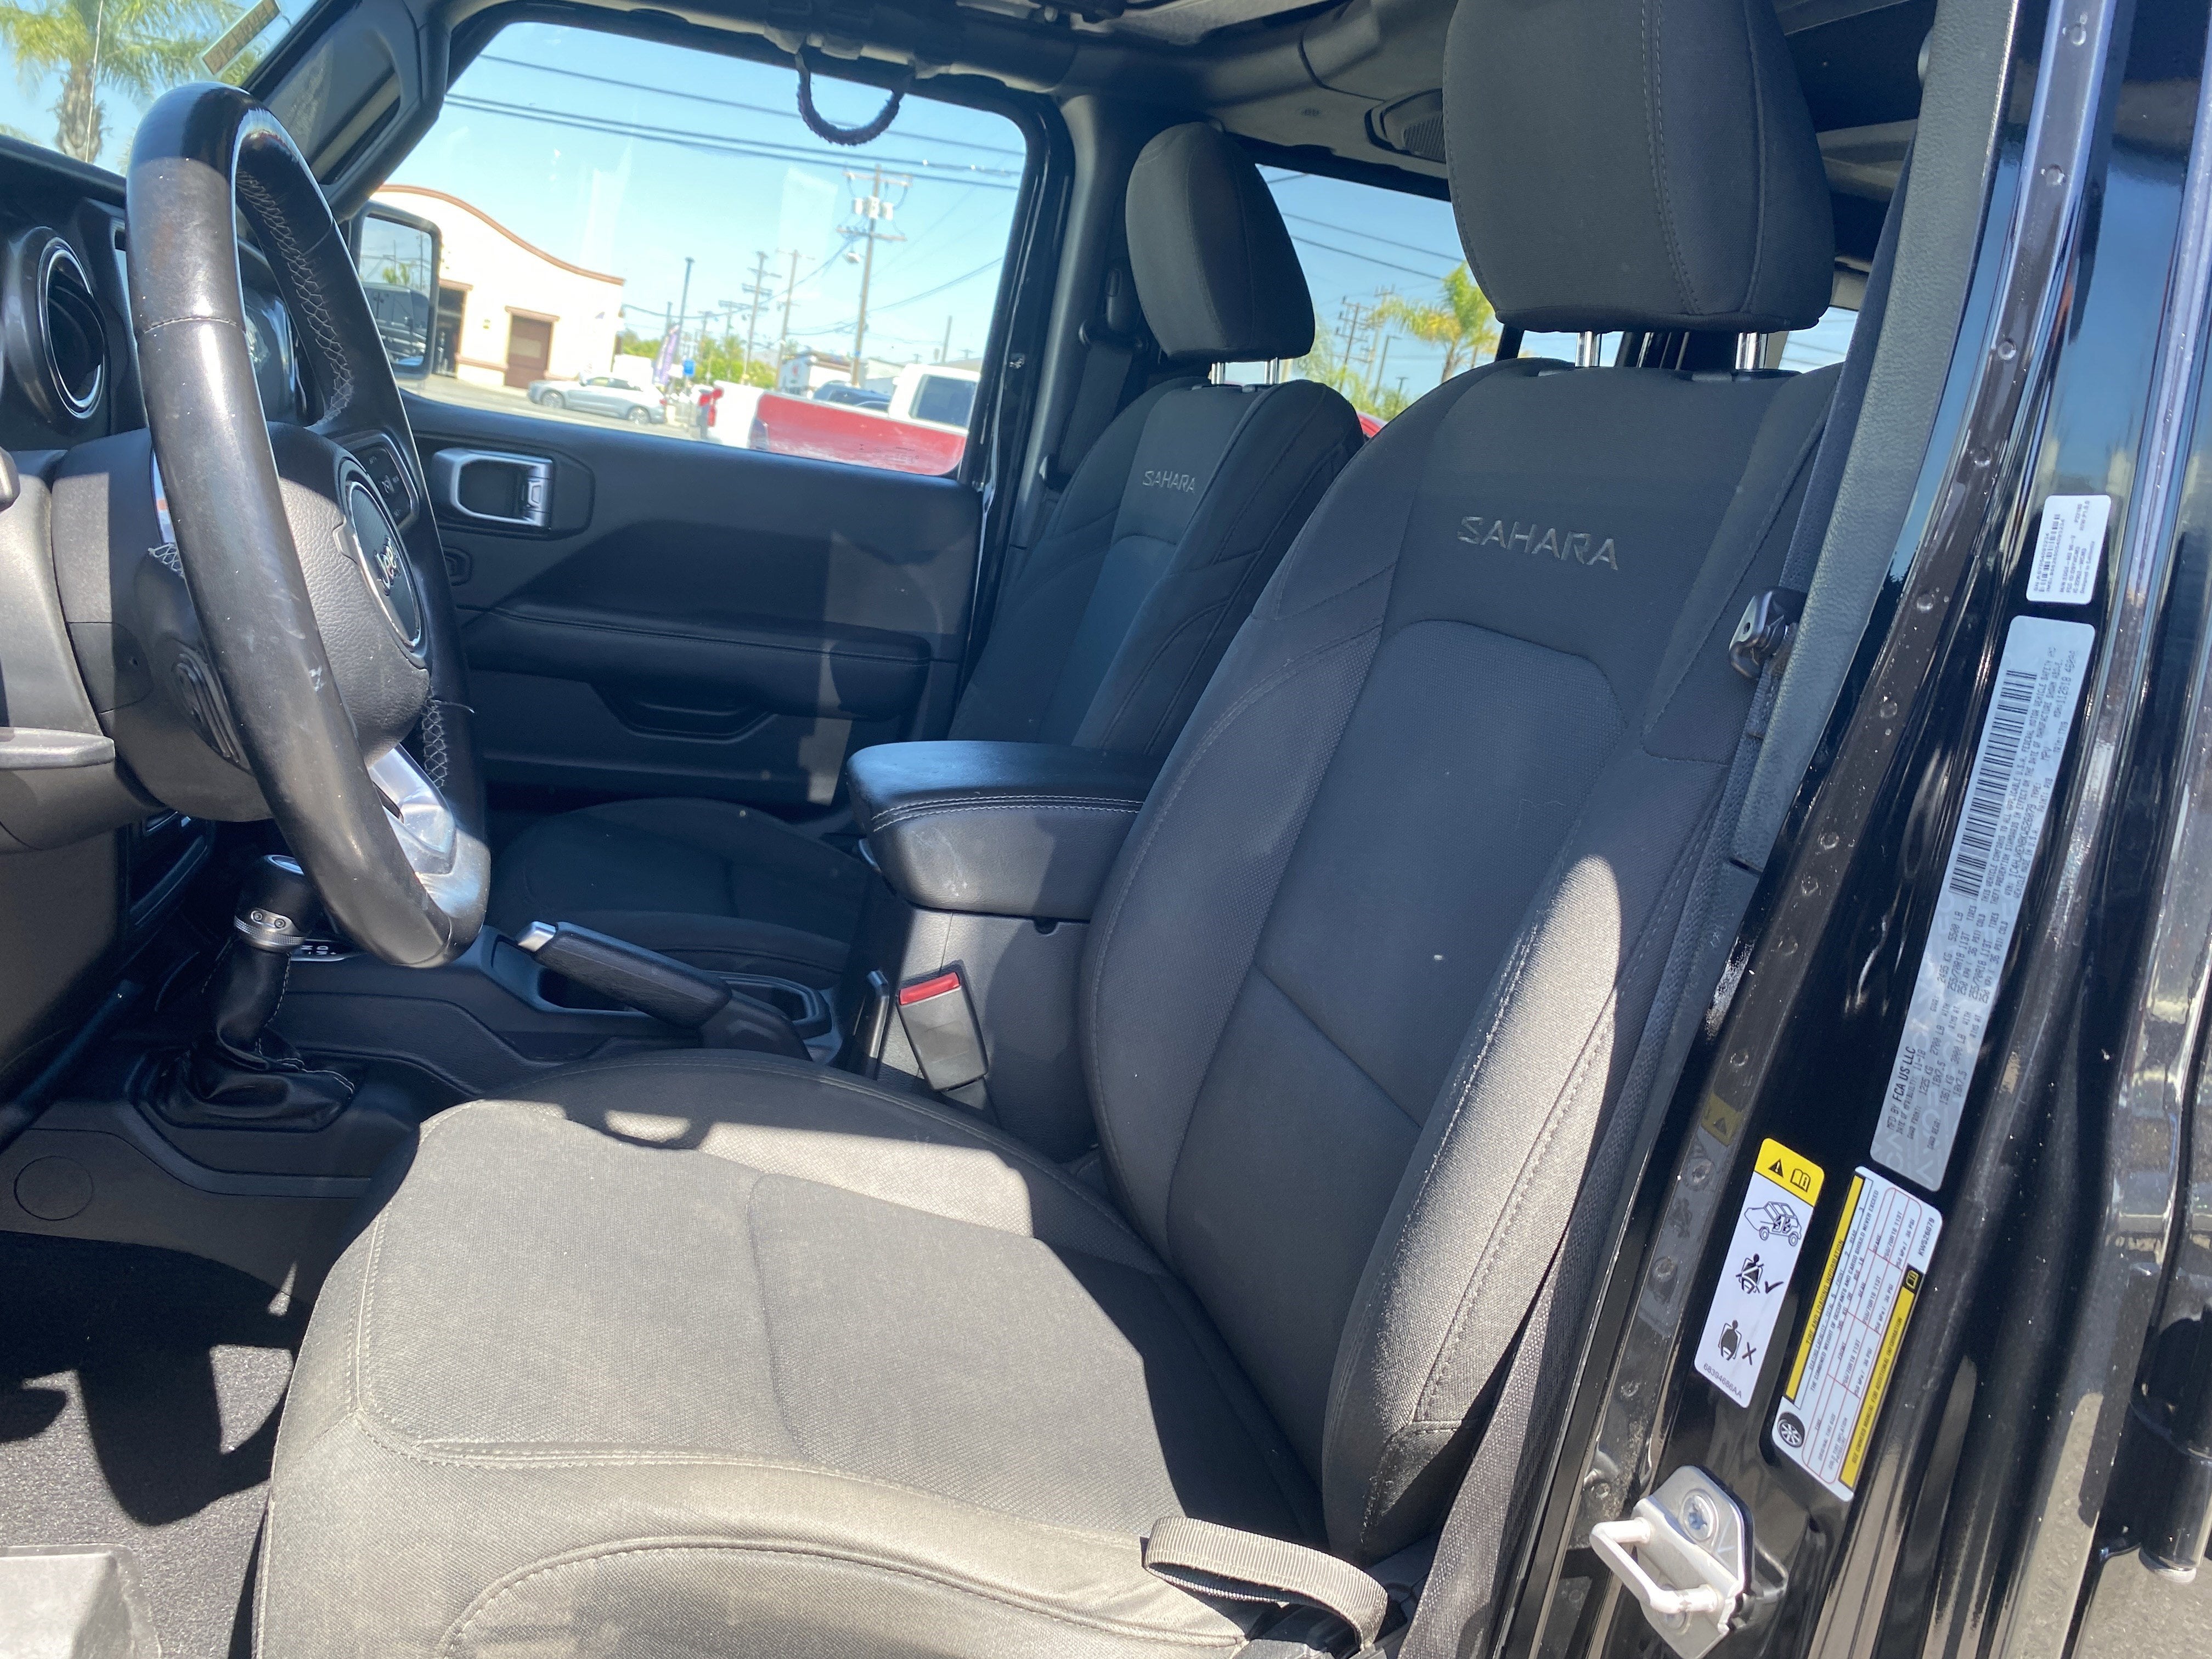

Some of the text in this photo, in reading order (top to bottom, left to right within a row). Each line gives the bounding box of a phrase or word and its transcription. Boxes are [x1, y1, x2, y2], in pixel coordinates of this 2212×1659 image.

[1142, 470, 1196, 495] SAHARA
[1456, 516, 1618, 571] SAHARA
[2040, 659, 2053, 680] SAFETY
[2033, 682, 2047, 707] VEHICLE
[2028, 708, 2040, 726] MOTOR
[2021, 729, 2034, 752] FEDERAL
[2027, 749, 2039, 764] DATE
[2024, 765, 2034, 776] THE
[2022, 778, 2030, 787] ON
[2005, 777, 2021, 811] APPLICABLE
[2016, 788, 2028, 810] EFFECT
[2036, 791, 2049, 812] PAINT:
[2002, 812, 2012, 823] ALL
[2004, 881, 2014, 896] VIN:
[2030, 782, 2041, 799] TYPE:
[2039, 746, 2052, 761] MPV
[2013, 811, 2022, 819] IN
[2004, 820, 2019, 851] STANDARDS
[1991, 834, 2006, 862] CONFORMS
[2024, 848, 2033, 856] IN
[1985, 863, 1998, 887] VEHICLE
[1995, 853, 2011, 887] PREVENTION
[2020, 858, 2030, 873] MADE
[1981, 888, 1991, 902] THIS
[2013, 874, 2026, 899] VEHICLE
[1953, 910, 1963, 922] LB
[1966, 904, 1977, 922] TIRES
[1976, 912, 1985, 928] COLD
[1988, 911, 1999, 929] TIRES
[1947, 922, 1960, 943] 5500
[1997, 919, 2008, 935] COLD
[1958, 930, 1971, 950] 113T
[1979, 938, 1992, 957] 113T
[1942, 951, 1953, 963] KG
[1967, 945, 1977, 957] 36
[1989, 952, 2000, 964] 36
[1936, 963, 1949, 984] 2495
[1946, 951, 1965, 992] 255/70R18
[1961, 966, 1971, 979] KPA
[1968, 958, 1987, 1000] 255/70R18
[1956, 979, 1968, 996] 250
[1978, 988, 1990, 1004] 250
[1940, 1001, 1950, 1017] WITH
[1952, 1005, 1960, 1014] AT
[1961, 1009, 1972, 1026] WITH
[1973, 1013, 1982, 1023] AT
[1935, 1023, 1945, 1036] LB
[1948, 1014, 1957, 1030] RIMS
[1969, 1022, 1979, 1039] RIMS
[1929, 1036, 1942, 1056] 2700
[1955, 1032, 1966, 1045] LB
[1950, 1044, 1962, 1065] 3000
[1923, 1063, 1933, 1076] KG
[1944, 1073, 1955, 1086] KG
[1886, 1044, 1916, 1131] MFD BY FCA US LLC
[1895, 1119, 1905, 1135] DATE
[1900, 1110, 1908, 1120] OF
[1913, 1047, 1926, 1072] 11-18
[1918, 1076, 1930, 1096] 1225
[1939, 1086, 1951, 1106] 1361
[1910, 1103, 1922, 1126] FRONT:
[1917, 1216, 1935, 1257] KW526079
[1805, 1238, 1844, 1345] TIRE AND LOADING INFORMATION
[1814, 1350, 1826, 1380] COMBINED
[1823, 1328, 1833, 1351] WEIGHT
[1830, 1319, 1836, 1329] OF
[1833, 1286, 1847, 1321] OCCUPANTS
[1848, 1254, 1858, 1274] CARGO
[1854, 1231, 1865, 1255] SHOULD
[1862, 1211, 1872, 1232] NEVER
[1868, 1189, 1879, 1212] EXCEED
[1841, 1305, 1848, 1316] KG
[1846, 1291, 1853, 1301] OR
[1858, 1256, 1864, 1266] LB
[1808, 1348, 1818, 1370] SEATING
[1815, 1324, 1826, 1350] CAPACITY
[1835, 1268, 1844, 1286] FRONT
[1703, 1363, 1742, 1398] 68394686AA
